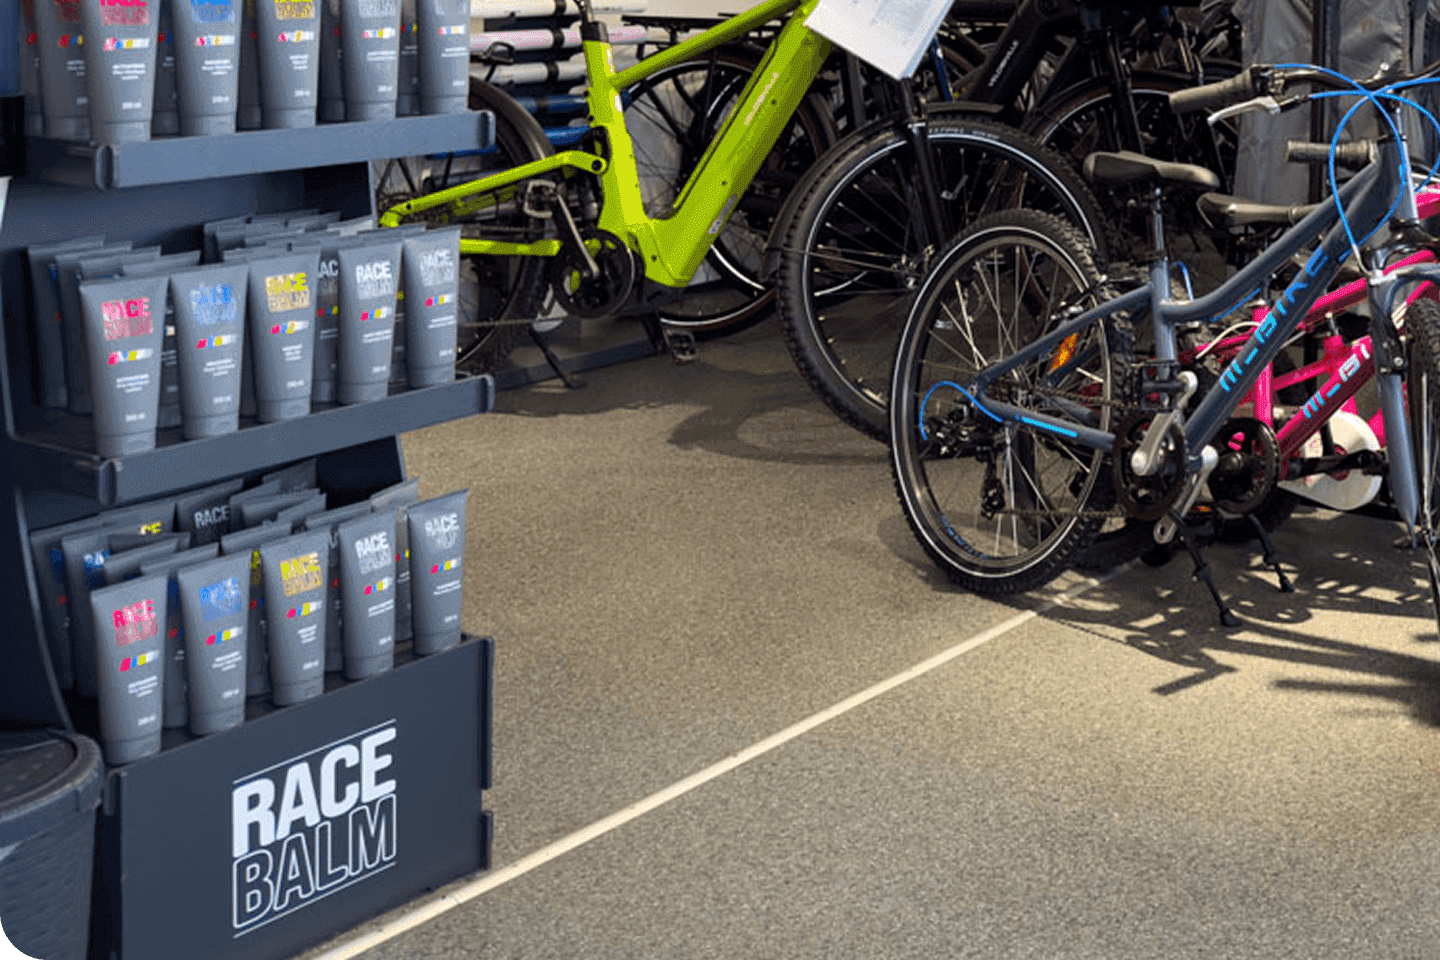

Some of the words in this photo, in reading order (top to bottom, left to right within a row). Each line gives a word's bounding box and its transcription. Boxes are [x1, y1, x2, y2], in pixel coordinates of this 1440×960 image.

[355, 260, 392, 283] RACE
[418, 249, 454, 271] RACE
[265, 272, 308, 295] RACE
[102, 297, 150, 321] RACE
[194, 504, 230, 529] RACE
[425, 512, 459, 536] RACE
[355, 532, 390, 558] RACE
[280, 552, 319, 581] RACE
[112, 598, 155, 628] RACE
[233, 727, 396, 859] RACE
[233, 793, 396, 930] BALM
